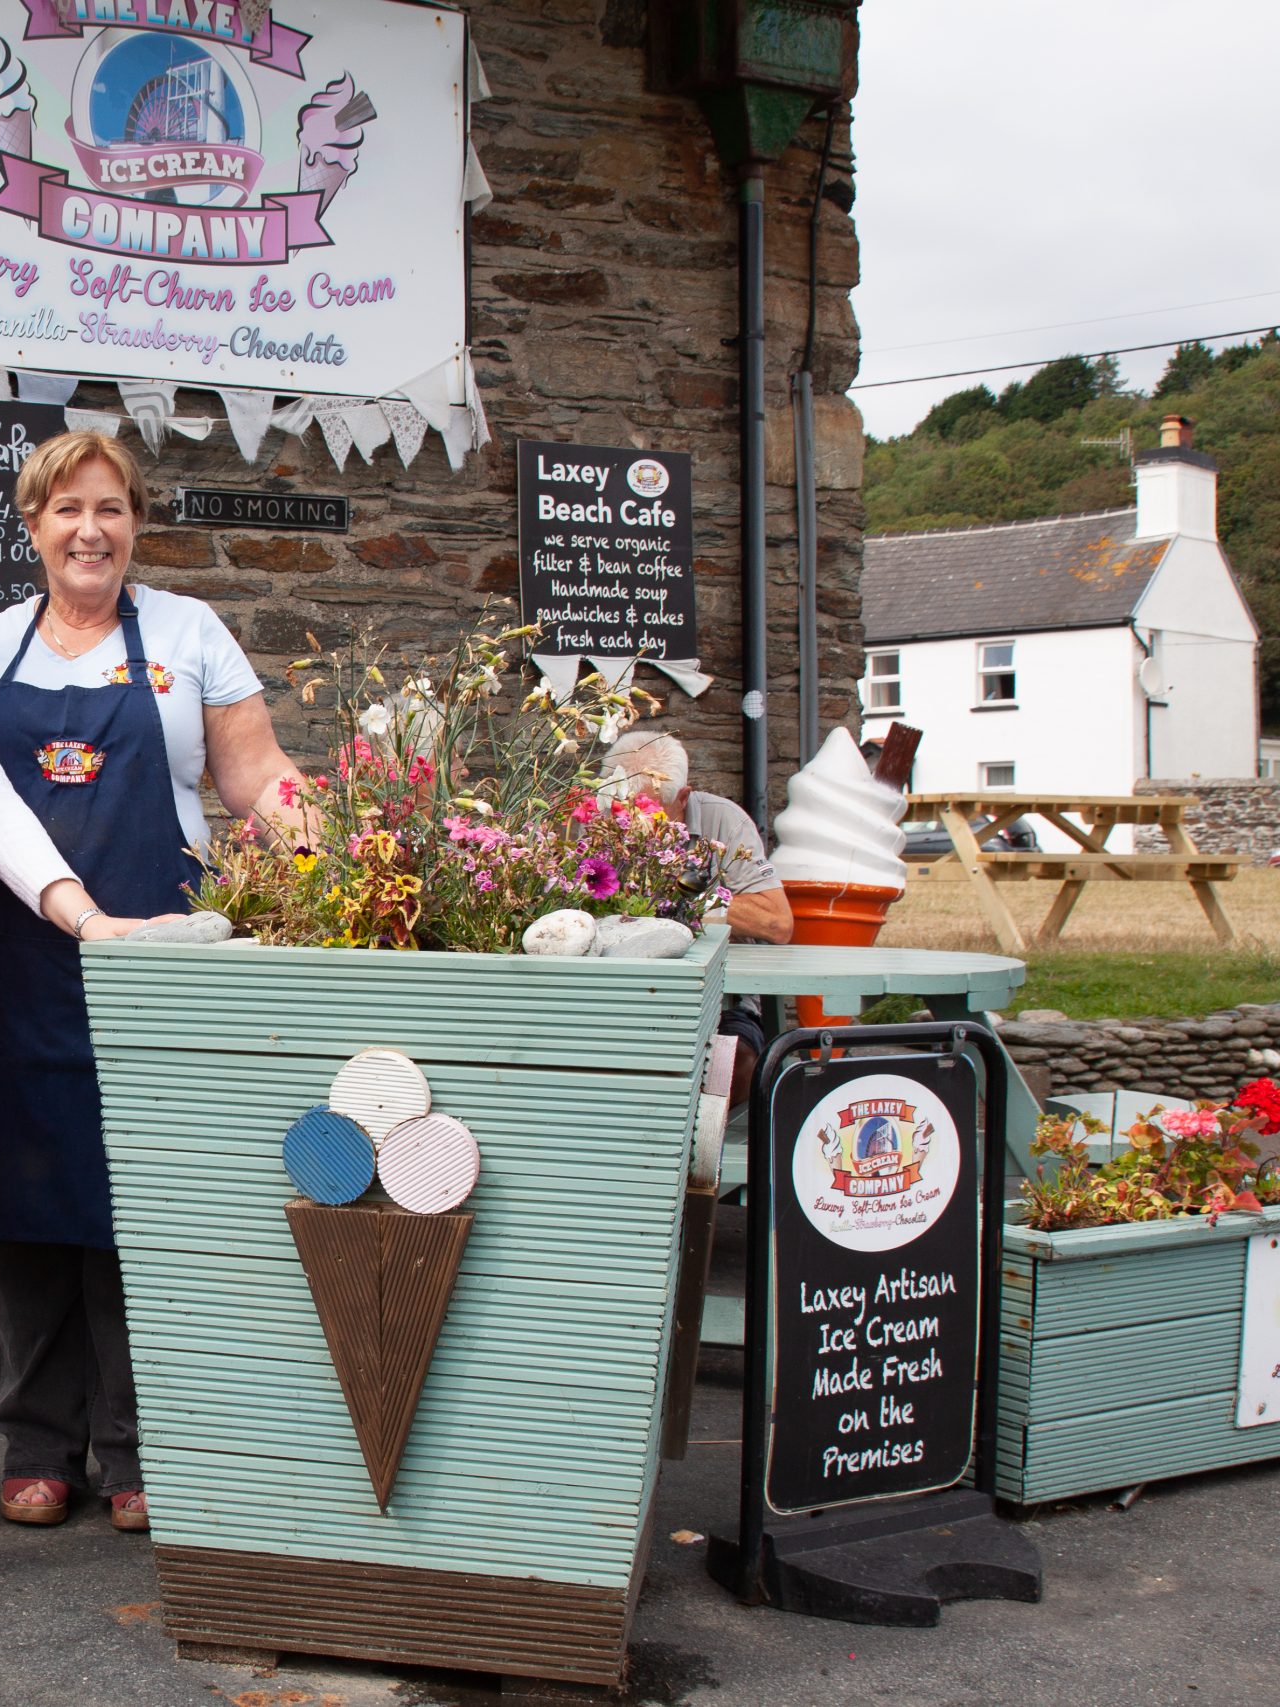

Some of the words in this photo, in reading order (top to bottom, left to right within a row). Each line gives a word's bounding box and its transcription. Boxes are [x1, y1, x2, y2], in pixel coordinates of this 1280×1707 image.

[61, 196, 268, 259] COMPANY
[70, 258, 236, 312] Soft-Churn
[249, 274, 296, 312] Ice
[307, 271, 396, 309] Cream
[537, 454, 610, 492] Laxey
[191, 495, 223, 516] NO
[233, 498, 337, 523] SMOKING
[538, 494, 613, 524] Beach
[619, 499, 676, 528] Cafe
[544, 535, 565, 547] we
[570, 534, 610, 549] serve
[615, 536, 671, 557] organic
[533, 550, 573, 576] filter
[579, 553, 592, 576] &
[597, 553, 631, 575] bean
[637, 556, 683, 581] coffee
[551, 578, 629, 600] Handmade
[635, 586, 668, 611] soup
[536, 602, 620, 623] sandwiches
[625, 604, 638, 627] &
[643, 606, 684, 626] cakes
[556, 626, 594, 651] fresh
[599, 631, 633, 649] each
[638, 630, 667, 659] day
[65, 742, 86, 750] LAXEY
[51, 774, 86, 783] COMPANY
[851, 1105, 870, 1118] THE
[871, 1102, 903, 1114] LAXEY
[849, 1175, 906, 1195] COMPANY
[813, 1196, 845, 1217] Luxury
[915, 1187, 941, 1203] Cream
[800, 1281, 866, 1326] Laxey
[874, 1267, 957, 1304] Artisan
[818, 1323, 857, 1354] Ice
[866, 1315, 939, 1347] Cream
[812, 1356, 873, 1400] Made
[882, 1347, 943, 1386] Fresh
[838, 1408, 870, 1434] on
[879, 1395, 915, 1428] the
[823, 1439, 924, 1478] Premises
